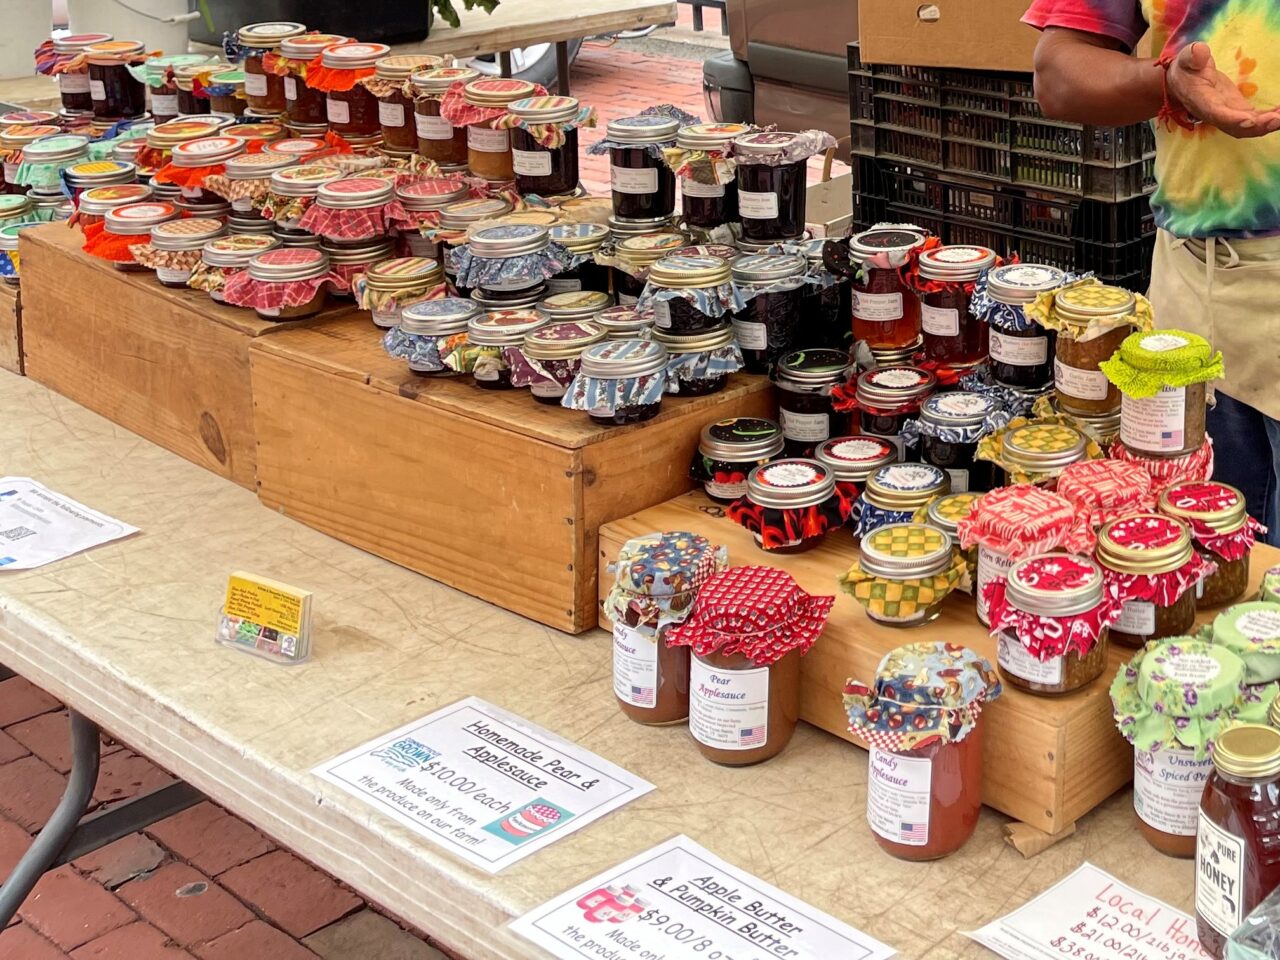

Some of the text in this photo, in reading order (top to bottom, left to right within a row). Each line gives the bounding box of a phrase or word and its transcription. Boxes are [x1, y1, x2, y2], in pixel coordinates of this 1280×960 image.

[981, 548, 1015, 568] Corn Reli
[698, 683, 746, 701] Applesauce
[710, 674, 731, 686] Pear
[392, 740, 435, 764] GROWN
[466, 720, 600, 790] Homemade Pear &
[468, 743, 549, 789] Applesauce
[875, 751, 898, 771] Candy
[420, 761, 512, 813] $10.00/each
[1159, 768, 1190, 782] Spiced
[358, 775, 487, 846] the produce on our farm!
[396, 778, 477, 826] Made only from
[1217, 841, 1237, 863] PURE
[1200, 854, 1235, 896] HONEY
[652, 875, 800, 959] & Pumpkin Butter
[691, 875, 803, 935] Apple Butter
[1095, 883, 1161, 926] Local
[561, 923, 586, 945] the
[605, 927, 665, 960] Made onl
